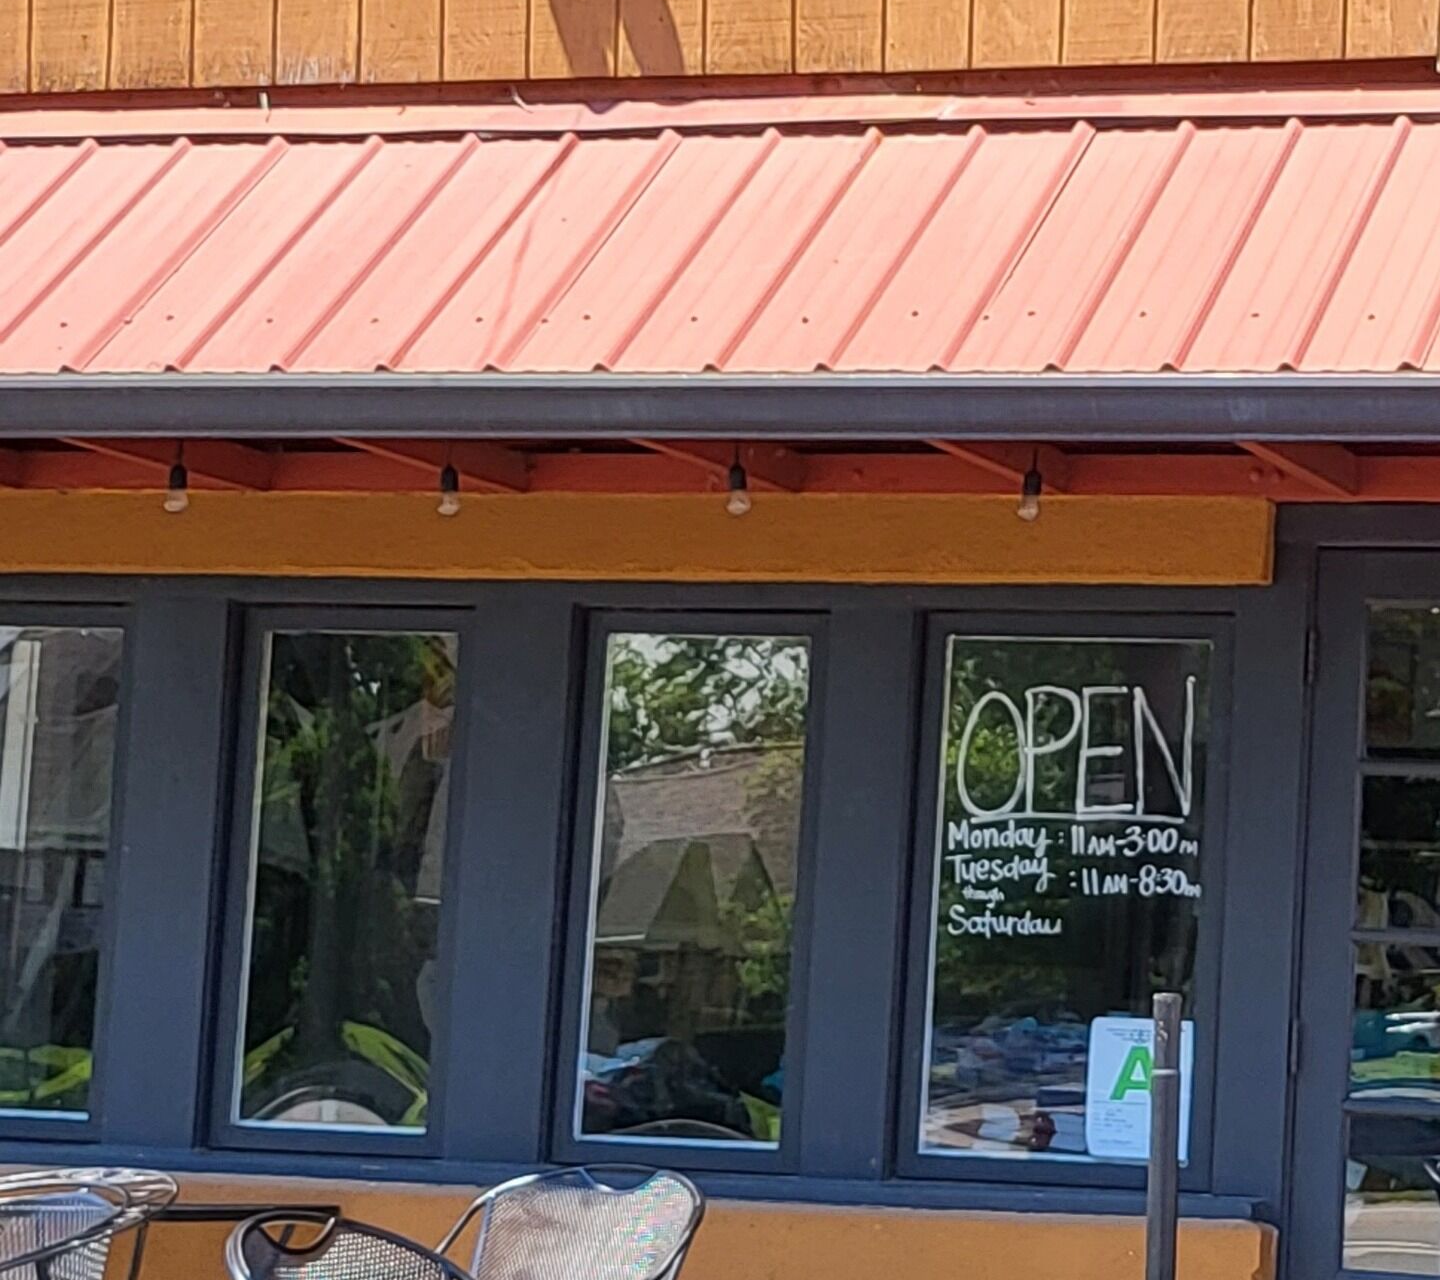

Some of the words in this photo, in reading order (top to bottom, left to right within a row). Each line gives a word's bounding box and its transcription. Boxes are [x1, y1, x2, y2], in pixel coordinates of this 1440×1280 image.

[956, 675, 1197, 820] OPEN
[947, 904, 1062, 939] Saturday
[1109, 1045, 1154, 1100] A
